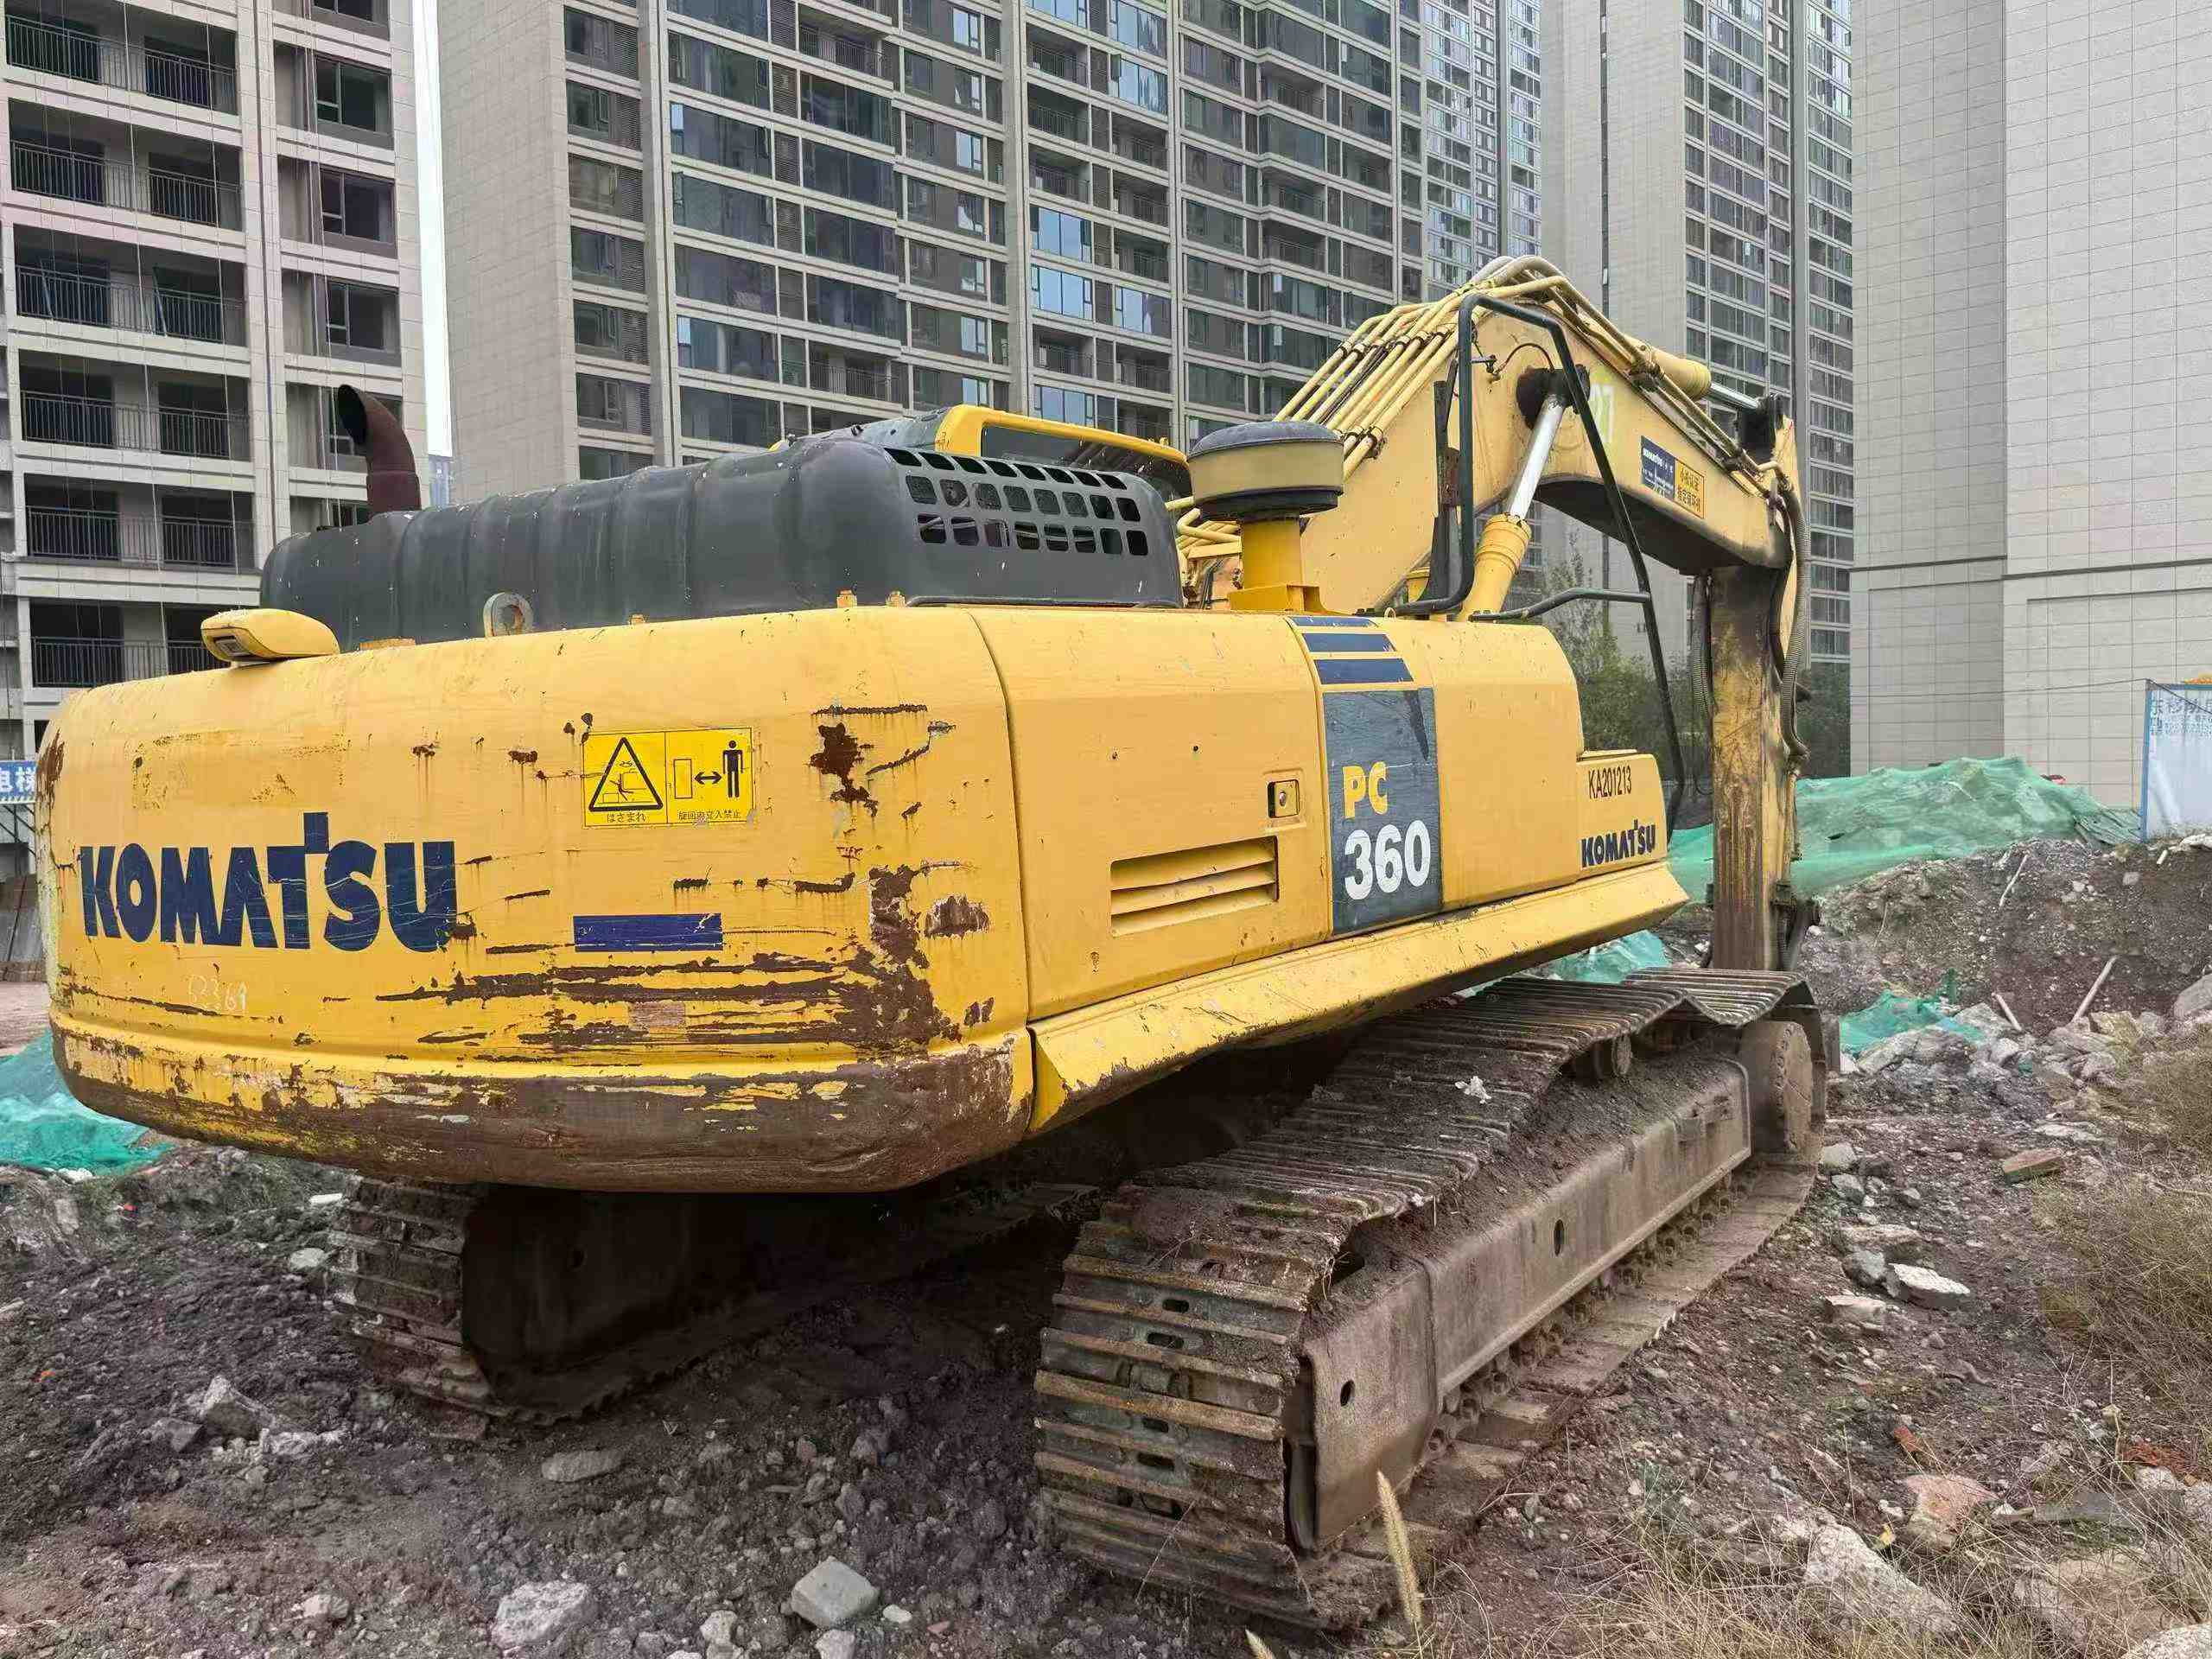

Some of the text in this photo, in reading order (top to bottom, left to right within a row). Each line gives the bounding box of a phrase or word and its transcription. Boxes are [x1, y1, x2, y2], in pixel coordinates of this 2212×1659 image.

[1342, 761, 1389, 818] PC
[1588, 765, 1632, 799] KA201213
[606, 811, 646, 823] はさまれ
[1581, 818, 1656, 868] KOMATSU
[79, 811, 458, 952] KOMATSU
[1344, 819, 1431, 900] 360
